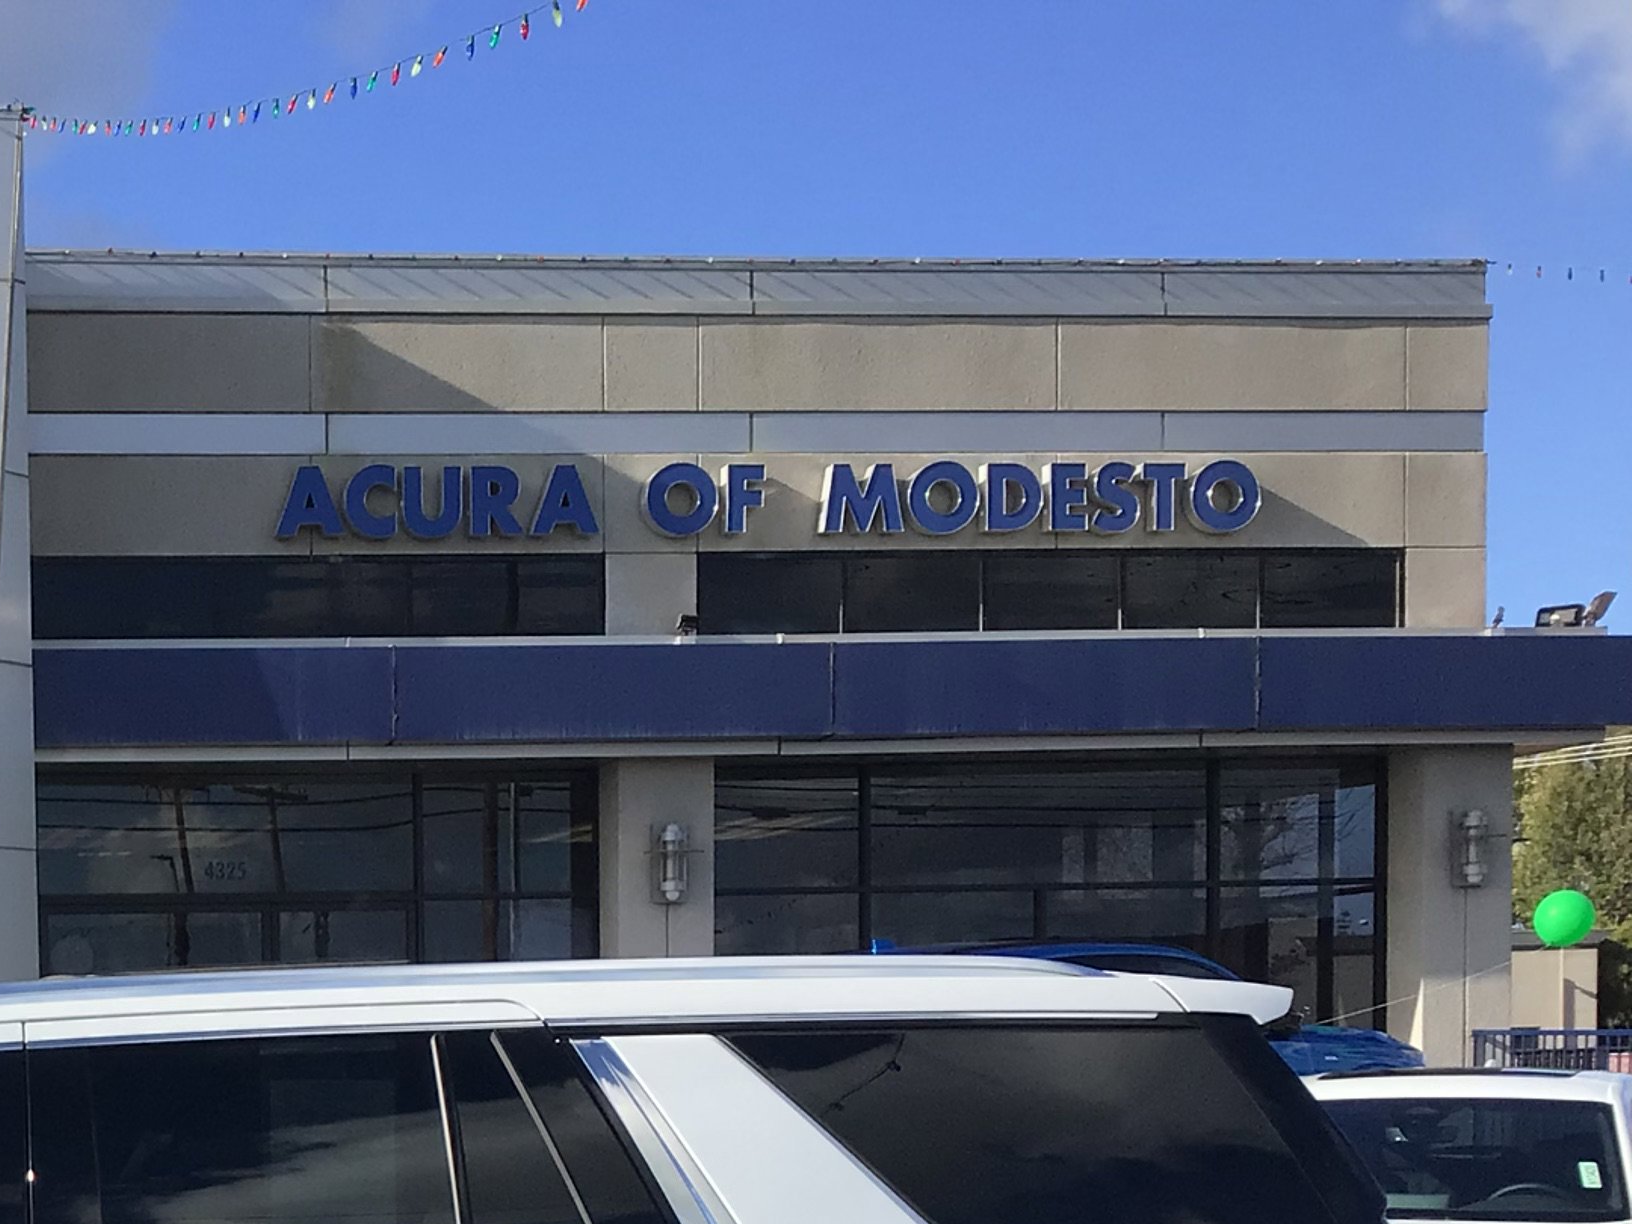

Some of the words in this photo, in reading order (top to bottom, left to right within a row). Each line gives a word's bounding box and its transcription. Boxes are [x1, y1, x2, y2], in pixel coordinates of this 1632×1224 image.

[275, 464, 600, 538] ACURA
[641, 461, 767, 537] OF
[817, 459, 1262, 535] MODESTO
[204, 861, 247, 880] 4325
